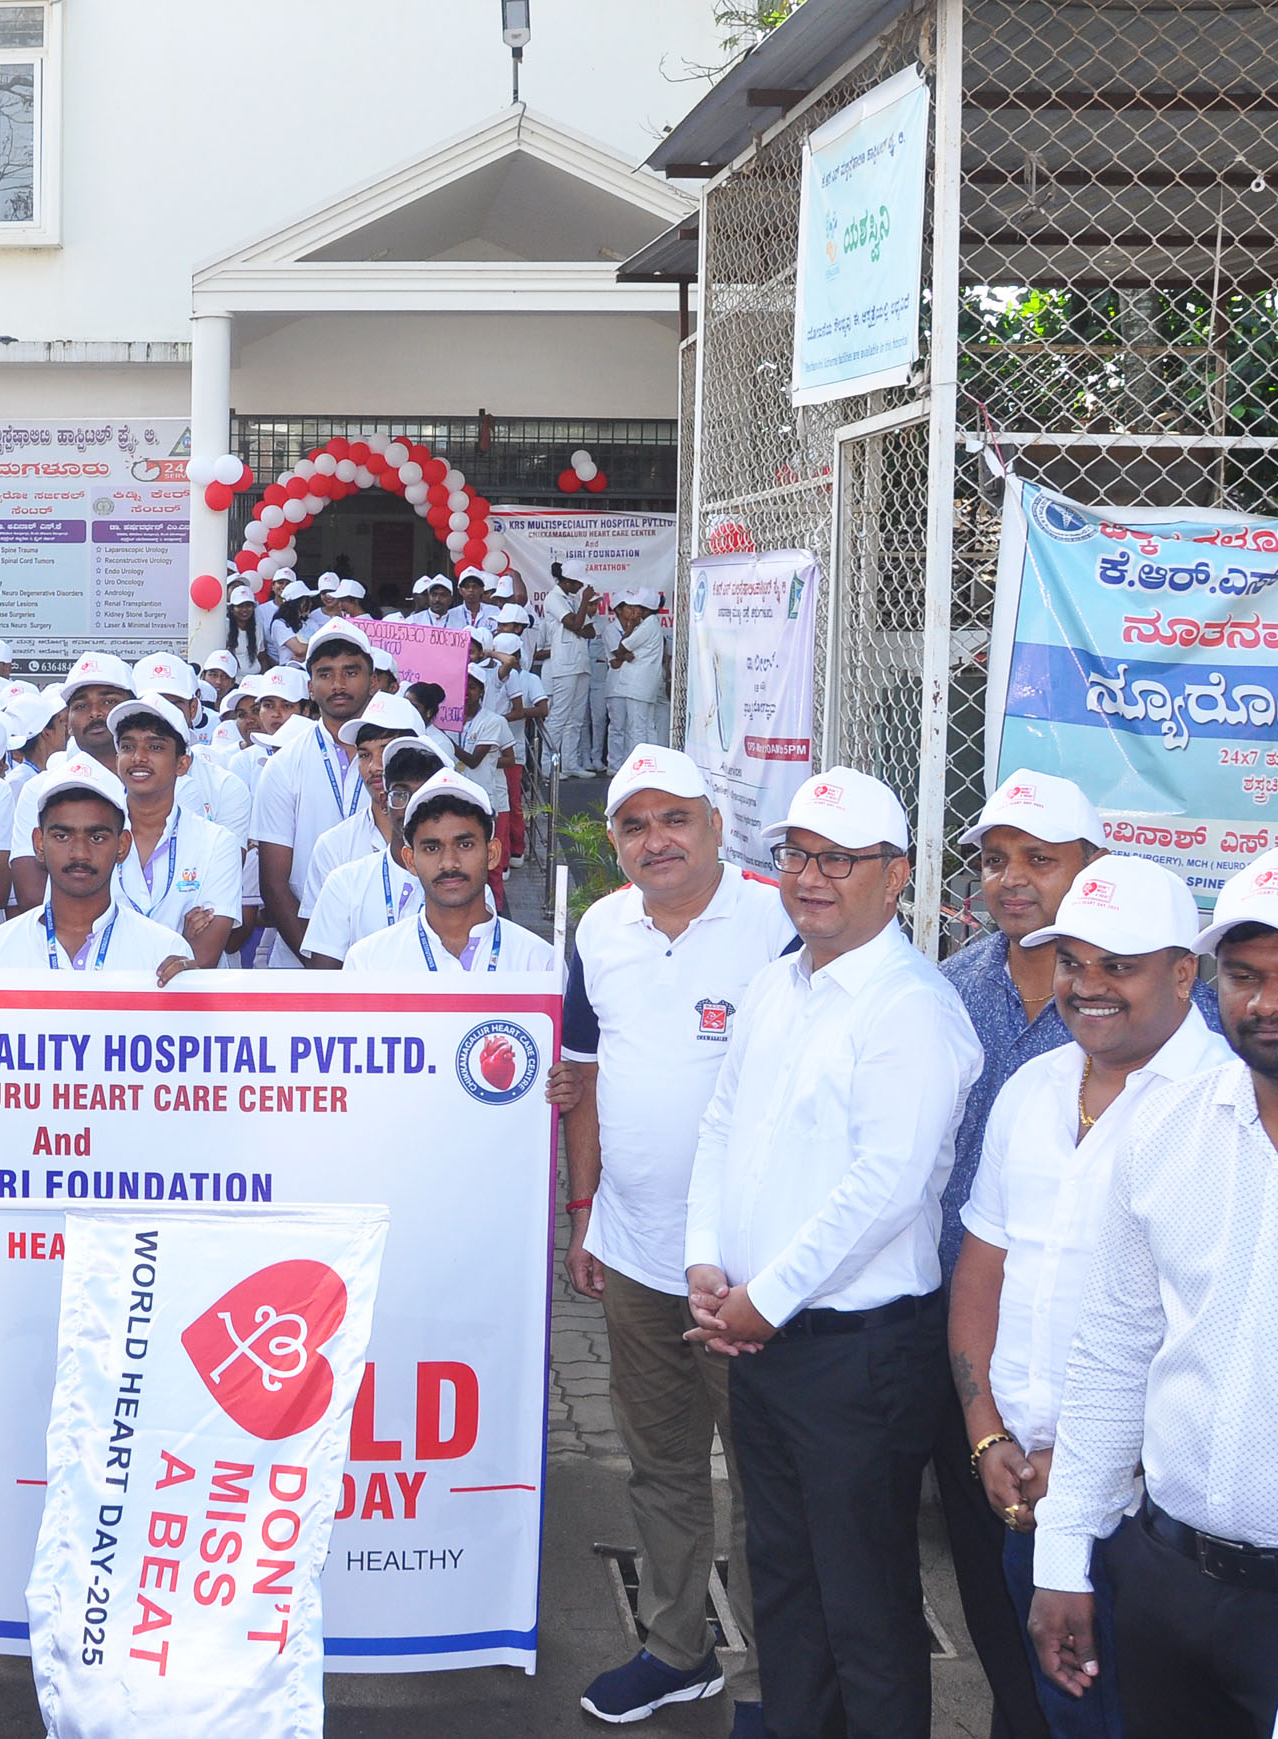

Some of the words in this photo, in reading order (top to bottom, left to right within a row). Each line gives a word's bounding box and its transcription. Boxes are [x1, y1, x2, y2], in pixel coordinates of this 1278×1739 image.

[510, 521, 525, 529] KRS
[527, 520, 598, 529] MULTISPECIALITY
[601, 519, 639, 528] HOSPITAL
[566, 550, 585, 558] ISIRI
[589, 550, 640, 558] FOUNDATION
[105, 590, 134, 598] Andrology
[1220, 749, 1259, 766] 24x7
[1187, 858, 1208, 869] MCH
[1186, 876, 1225, 889] SPINE
[491, 1024, 521, 1037] HEART
[519, 1035, 534, 1057] CARE
[105, 1034, 276, 1074] HOSPITAL
[291, 1036, 437, 1075] PVT.LTD.
[459, 1026, 490, 1092] CHIKKAMAGALUR
[517, 1058, 536, 1091] CENTRE
[53, 1083, 143, 1112] HEART
[154, 1084, 227, 1112] CARE
[240, 1085, 348, 1113] CENTER
[32, 1126, 91, 1157] And
[46, 1169, 273, 1202] FOUNDATION
[8, 1231, 65, 1260] HEA
[124, 1230, 159, 1360] WORLD
[349, 1361, 479, 1461] LD
[105, 1371, 143, 1493] HEART
[155, 1449, 196, 1491] A
[334, 1472, 427, 1520] DAY
[193, 1459, 255, 1607] MISS
[347, 1549, 464, 1571] HEALTHY
[81, 1504, 124, 1667] DAY-2025
[129, 1510, 189, 1677] BEAT
